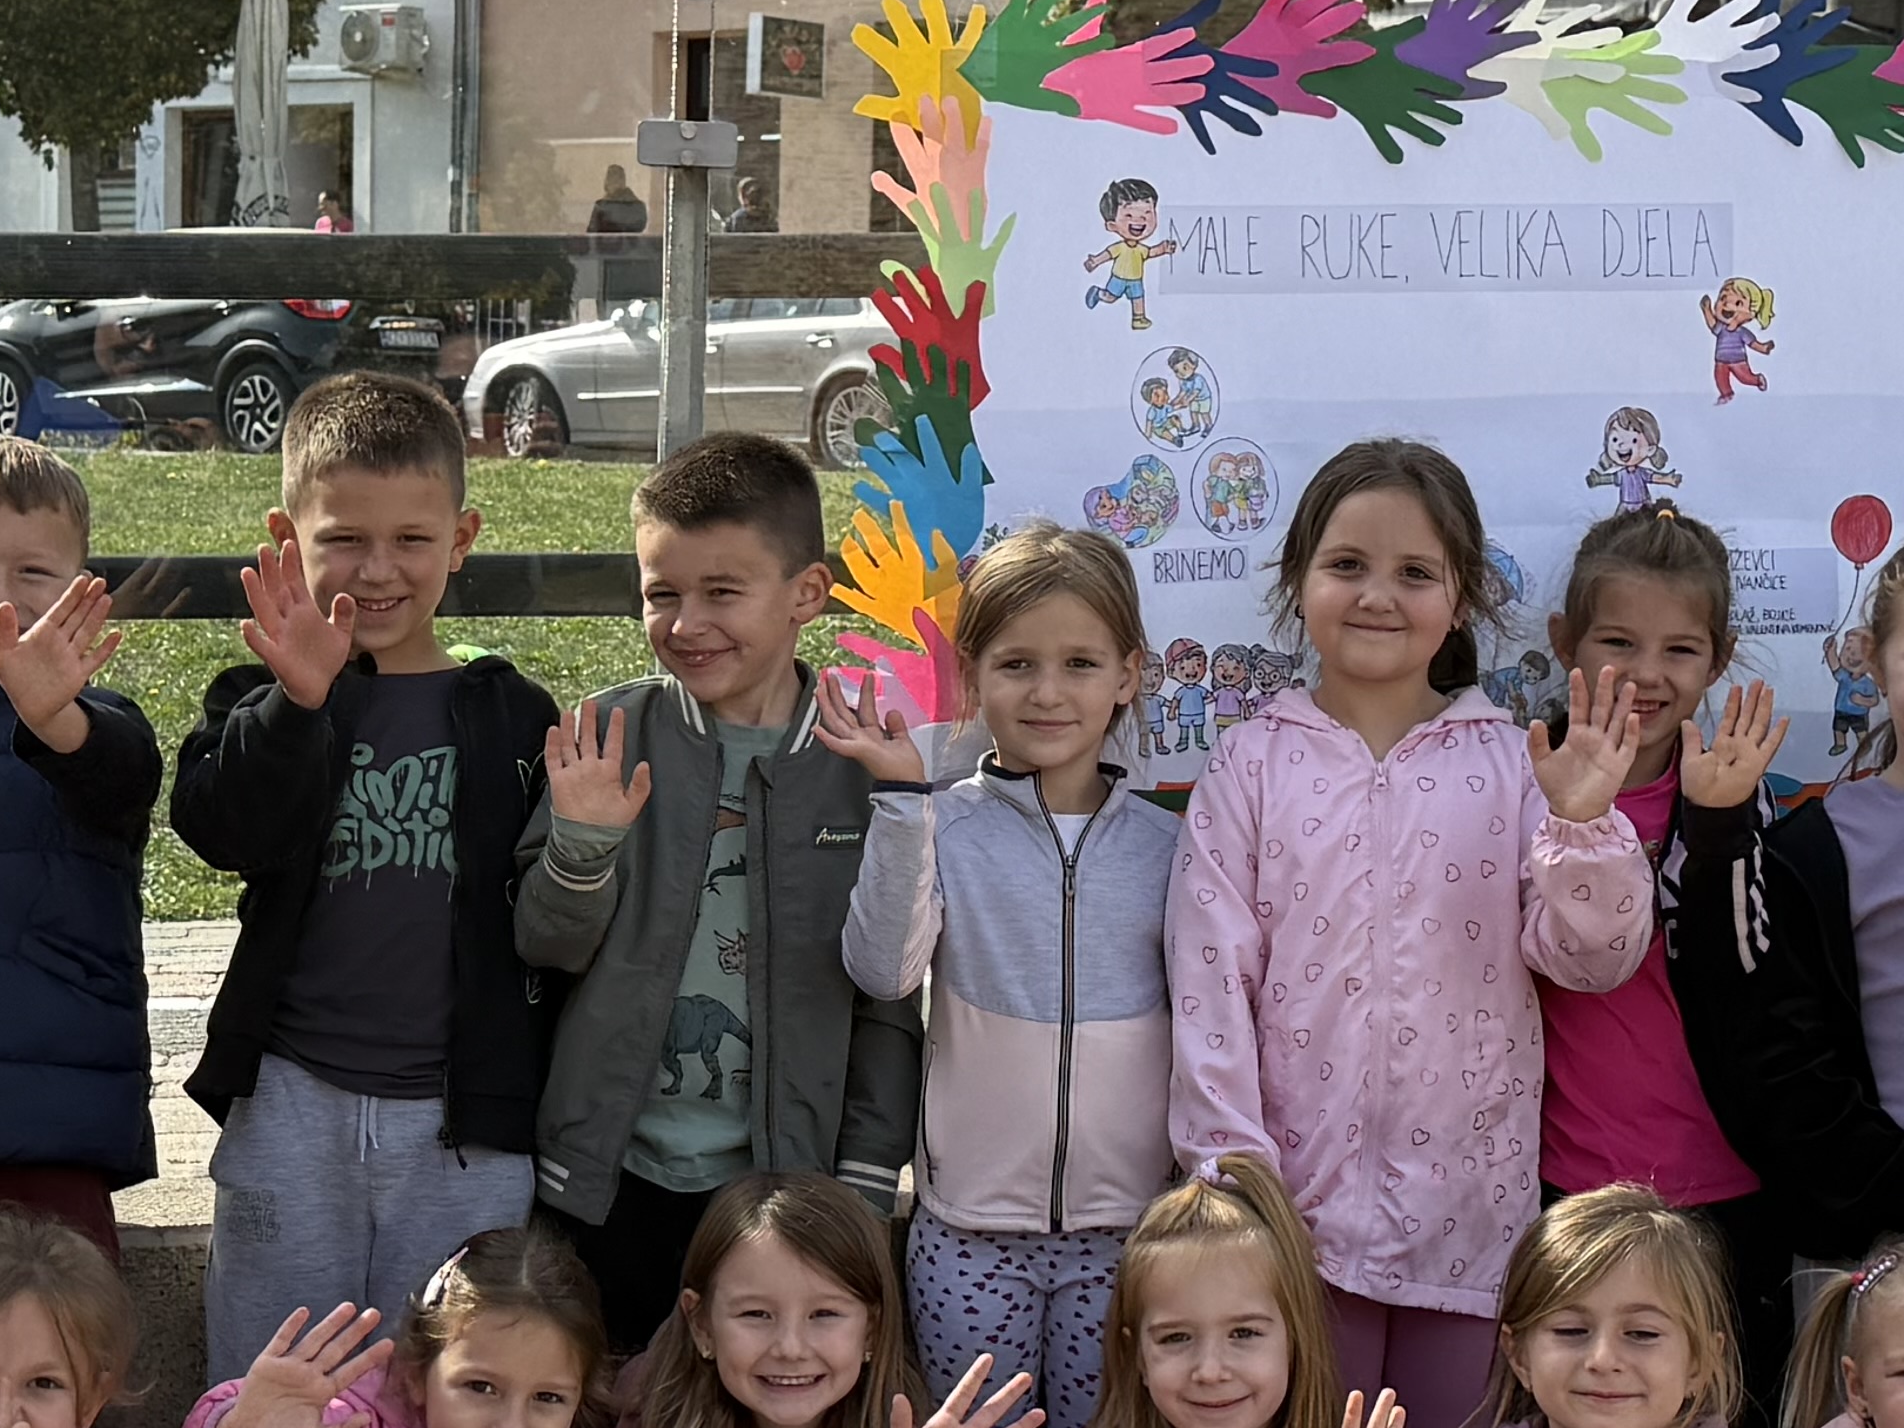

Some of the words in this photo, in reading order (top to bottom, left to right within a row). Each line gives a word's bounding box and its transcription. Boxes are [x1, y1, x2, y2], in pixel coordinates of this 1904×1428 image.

[1169, 215, 1264, 275] MALE
[1300, 212, 1410, 284] RUKE,
[1429, 209, 1573, 281] VELIKA
[1601, 208, 1720, 278] DJELA
[1152, 547, 1246, 584] BRINEMO
